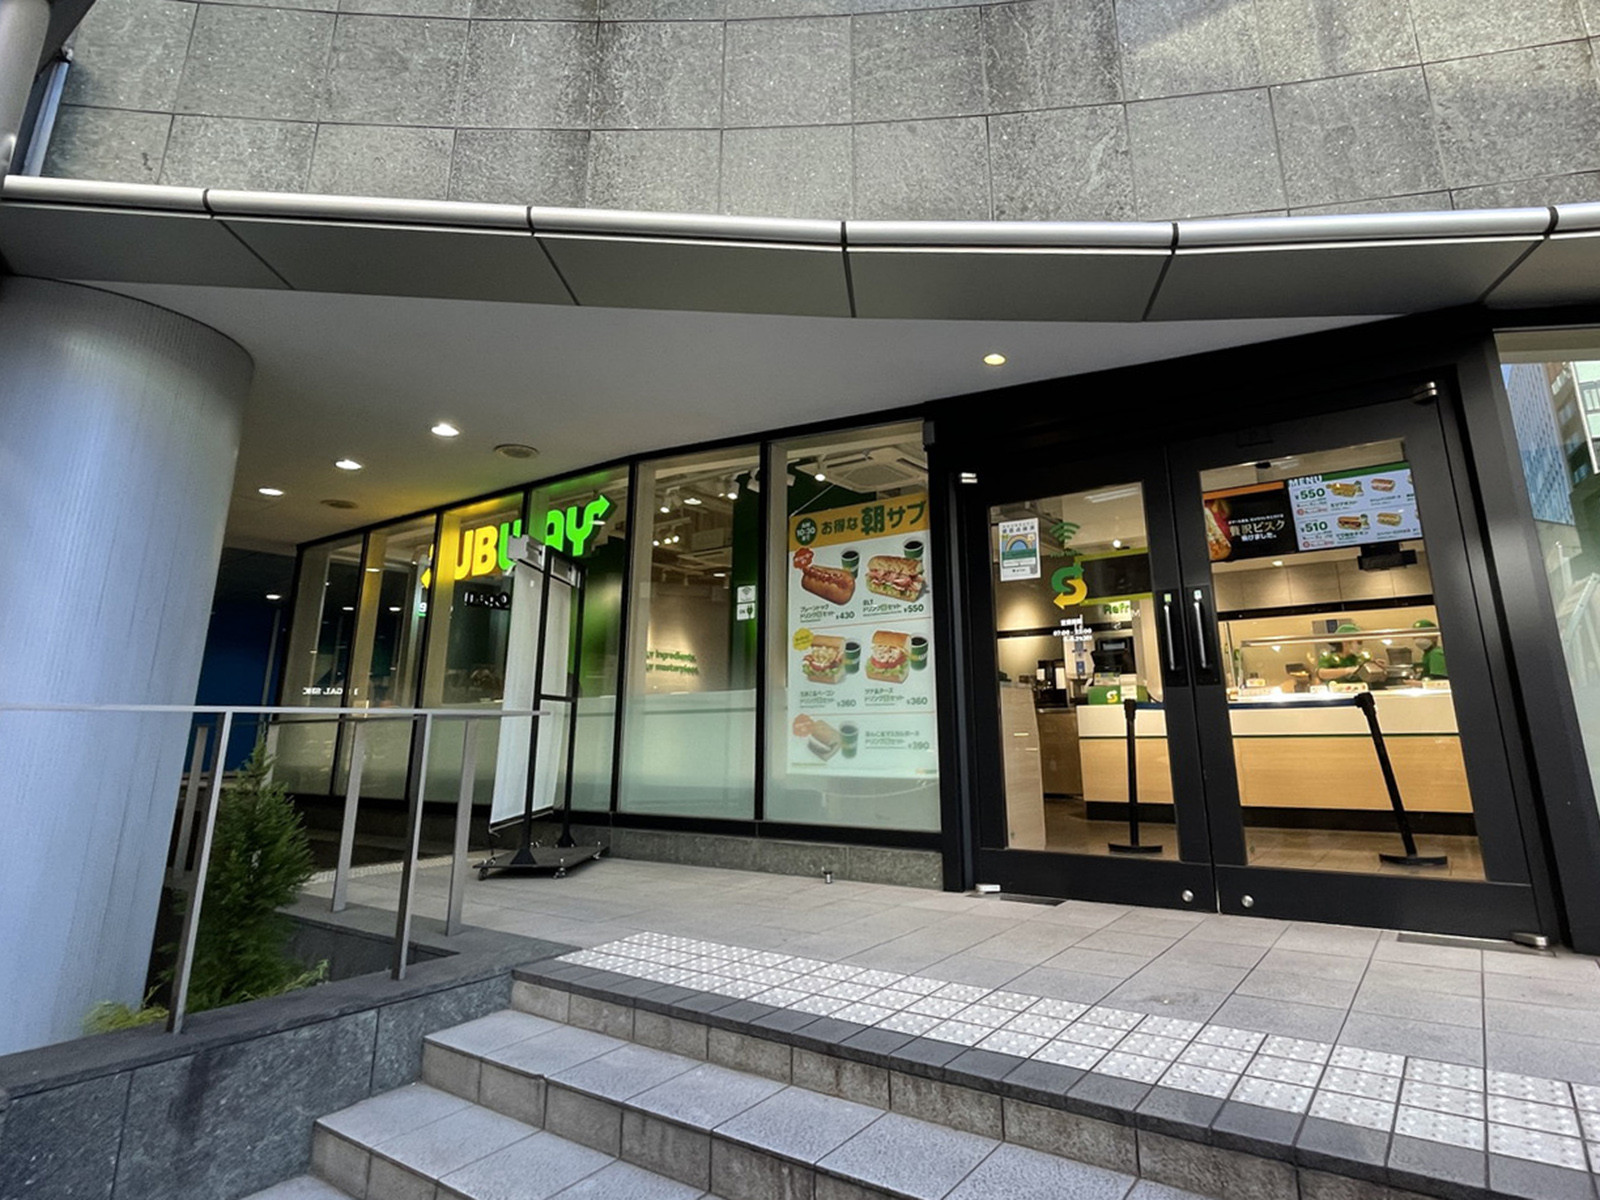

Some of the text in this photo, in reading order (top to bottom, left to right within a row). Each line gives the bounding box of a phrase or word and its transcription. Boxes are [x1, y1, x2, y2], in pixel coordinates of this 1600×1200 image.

[1288, 475, 1323, 488] MENU
[1294, 488, 1326, 500] ¥550
[1299, 521, 1328, 533] ¥510
[903, 604, 924, 613] ¥550
[836, 610, 855, 620] ¥430
